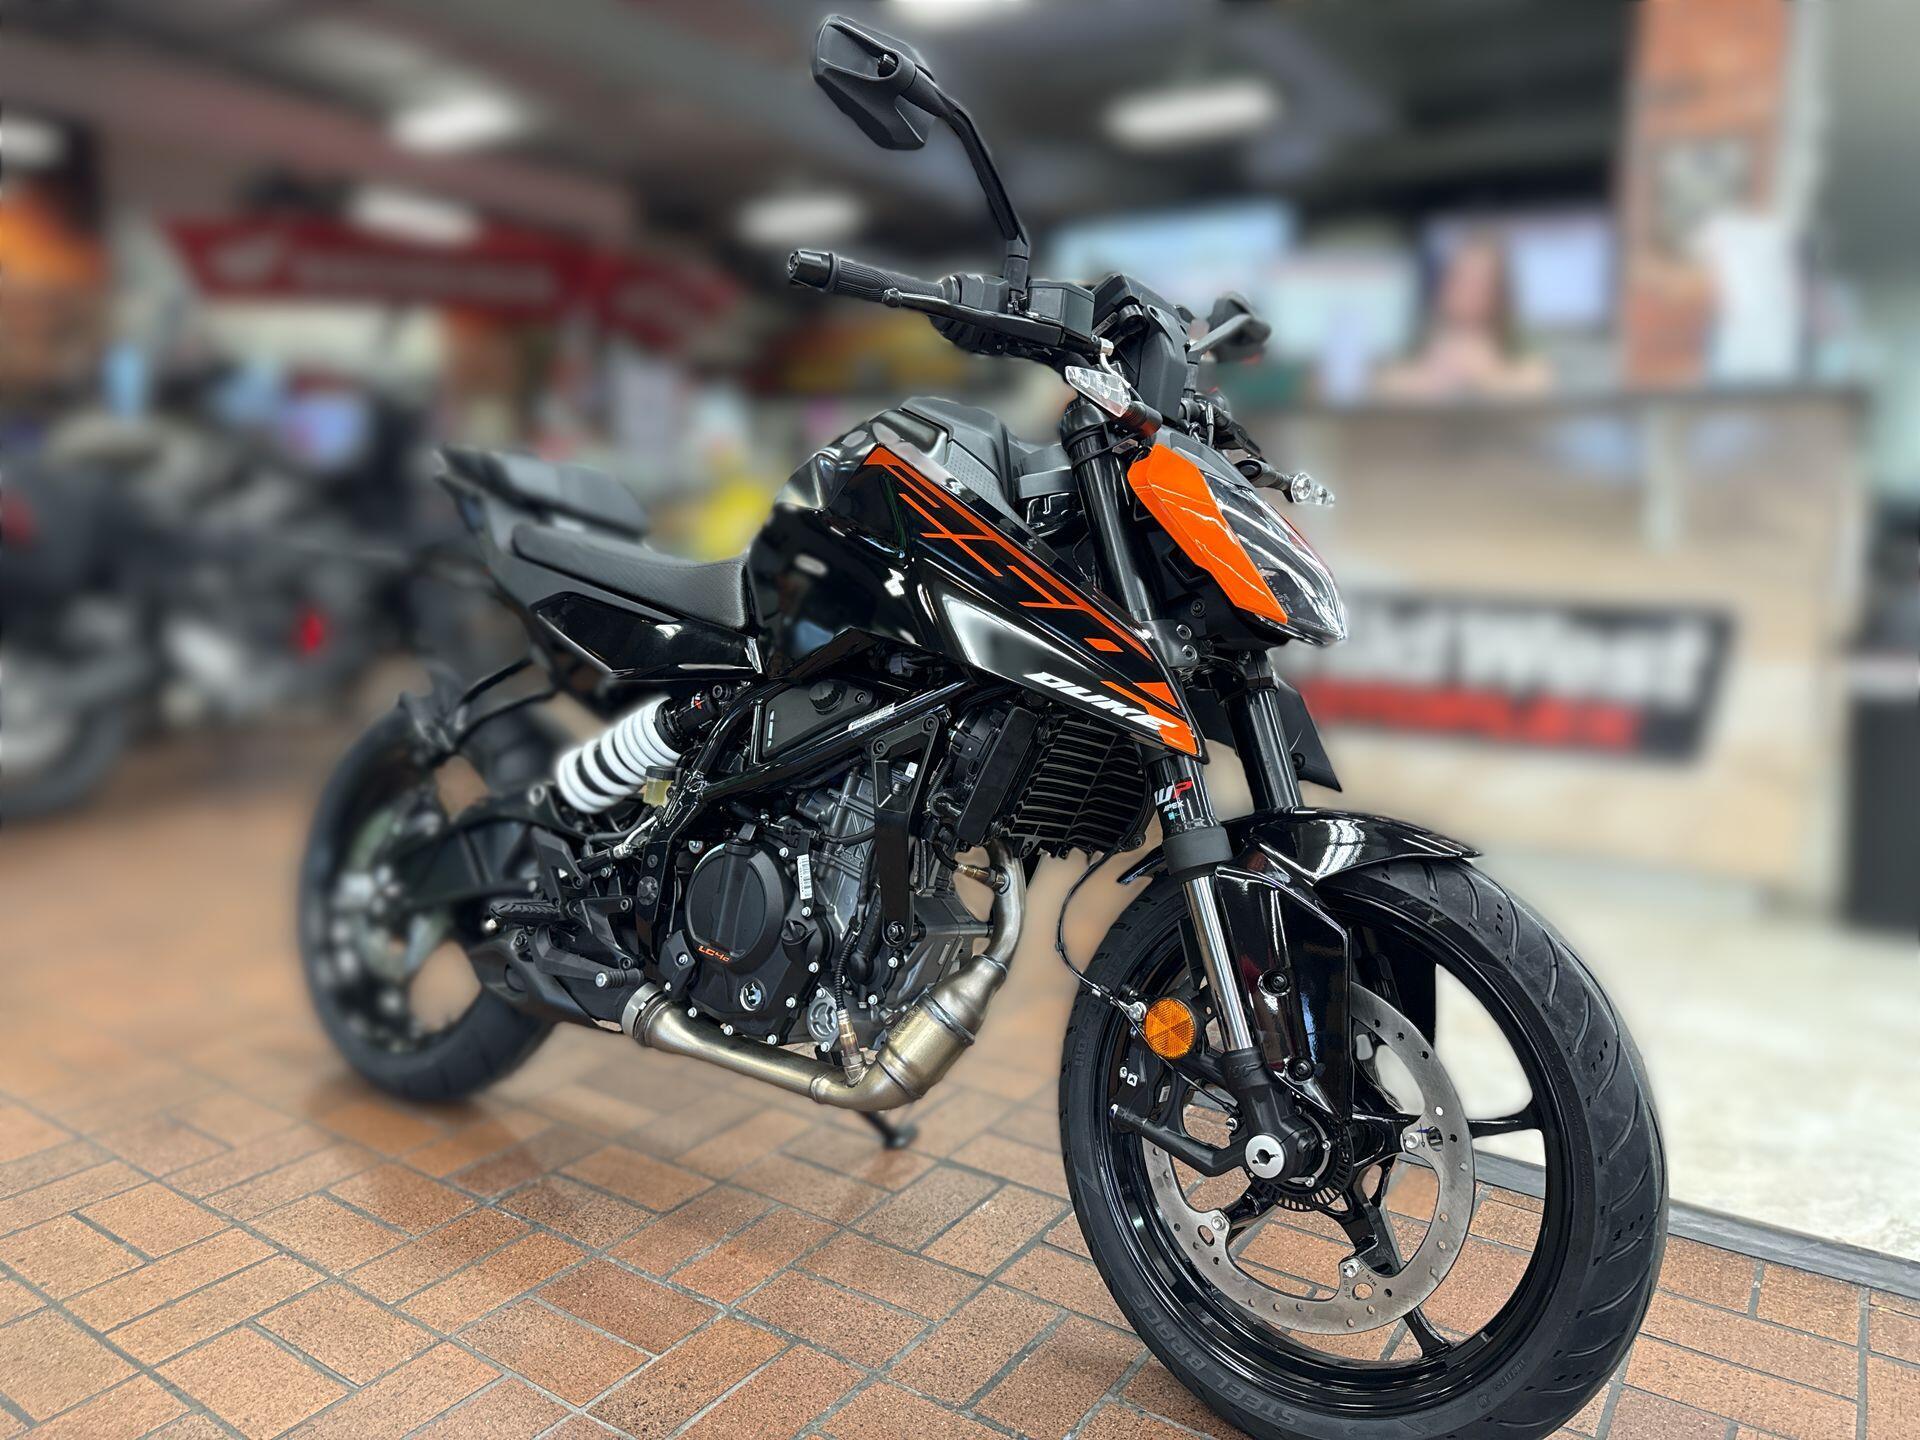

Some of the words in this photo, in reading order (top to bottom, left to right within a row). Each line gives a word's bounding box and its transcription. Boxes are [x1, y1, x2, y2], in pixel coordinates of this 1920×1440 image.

[1023, 671, 1178, 731] DUKE
[1154, 780, 1193, 806] WP
[1130, 1292, 1208, 1371] BRACE
[1213, 1370, 1301, 1425] STEEL
